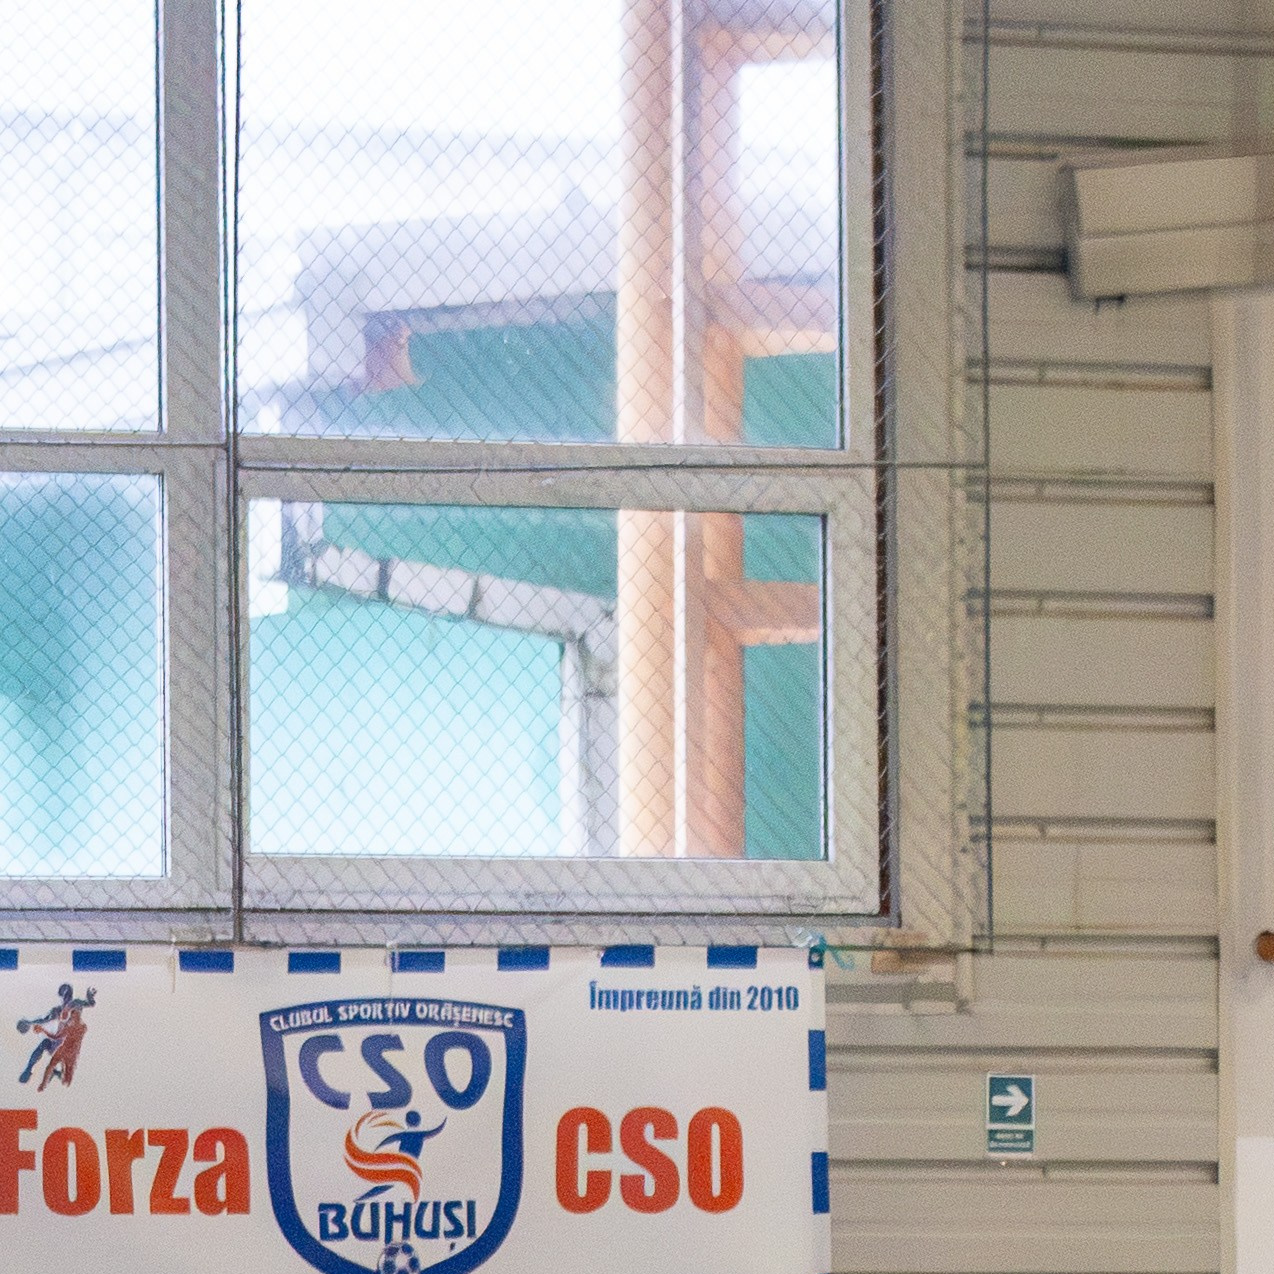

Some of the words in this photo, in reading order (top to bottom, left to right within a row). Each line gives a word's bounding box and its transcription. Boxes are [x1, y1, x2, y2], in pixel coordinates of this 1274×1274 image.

[269, 1006, 333, 1032] CLUBUL
[338, 1001, 411, 1021] SPORTIV
[708, 985, 741, 1009] din
[747, 985, 799, 1010] 2010
[298, 1031, 492, 1110] CSO
[0, 1109, 250, 1216] Forza
[555, 1106, 744, 1214] CSO
